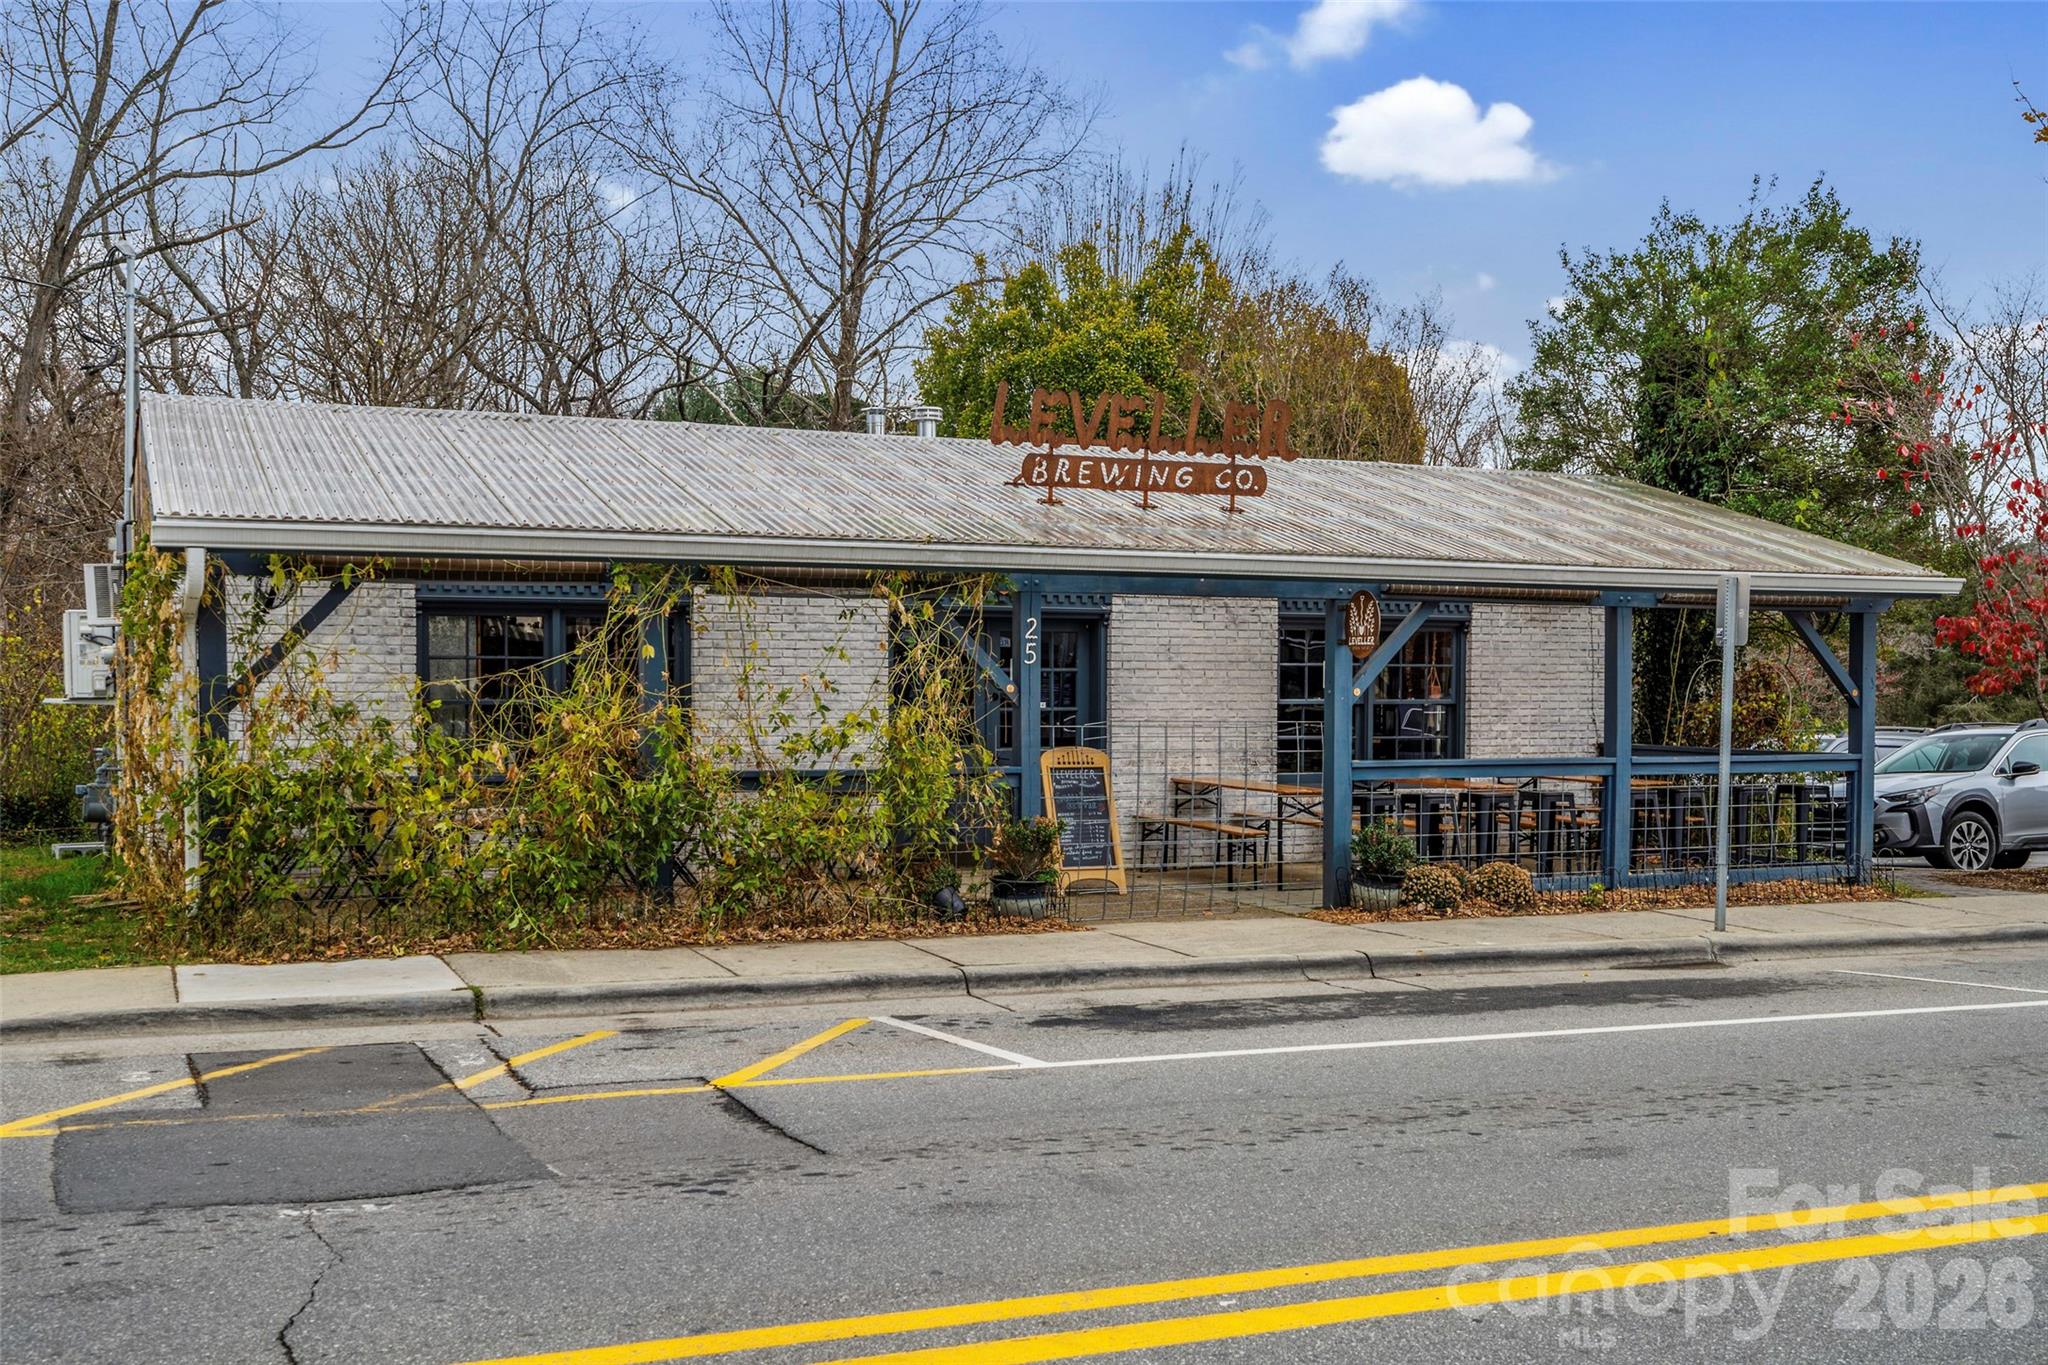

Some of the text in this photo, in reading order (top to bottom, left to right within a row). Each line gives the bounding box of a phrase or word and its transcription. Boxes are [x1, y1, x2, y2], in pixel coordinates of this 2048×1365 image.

[990, 381, 1299, 461] LEVELLER
[1031, 456, 1259, 491] BREWING CO.
[1348, 636, 1375, 646] LEVELLER
[1055, 769, 1097, 780] LEVELLER
